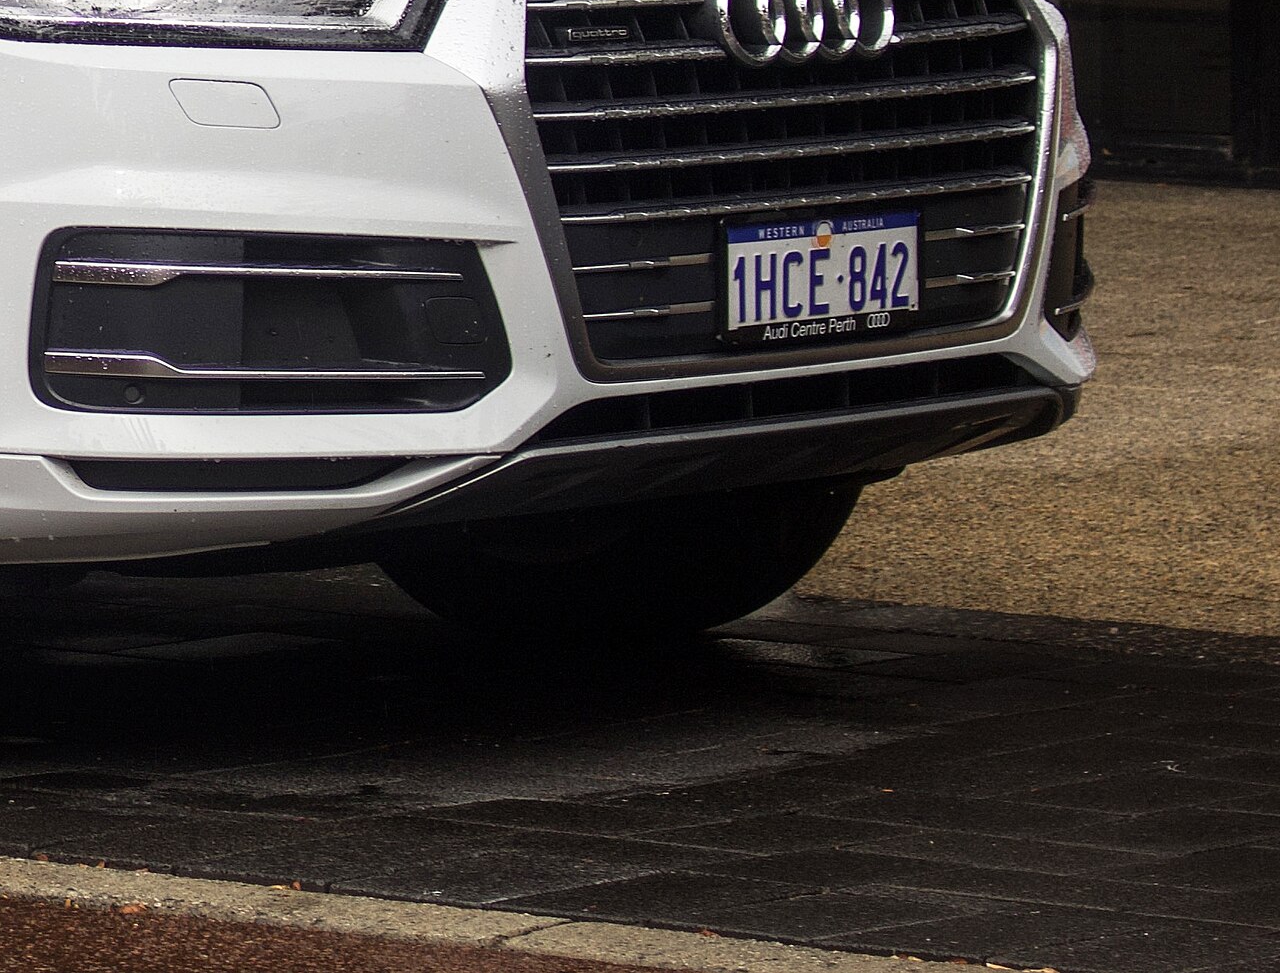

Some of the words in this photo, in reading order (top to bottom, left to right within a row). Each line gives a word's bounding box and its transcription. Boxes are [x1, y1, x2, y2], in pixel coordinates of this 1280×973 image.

[758, 226, 805, 239] WESTERN
[842, 218, 884, 231] AUSTRALIA
[762, 324, 789, 341] Audi
[790, 321, 826, 337] Centre
[827, 317, 857, 334] Perth
